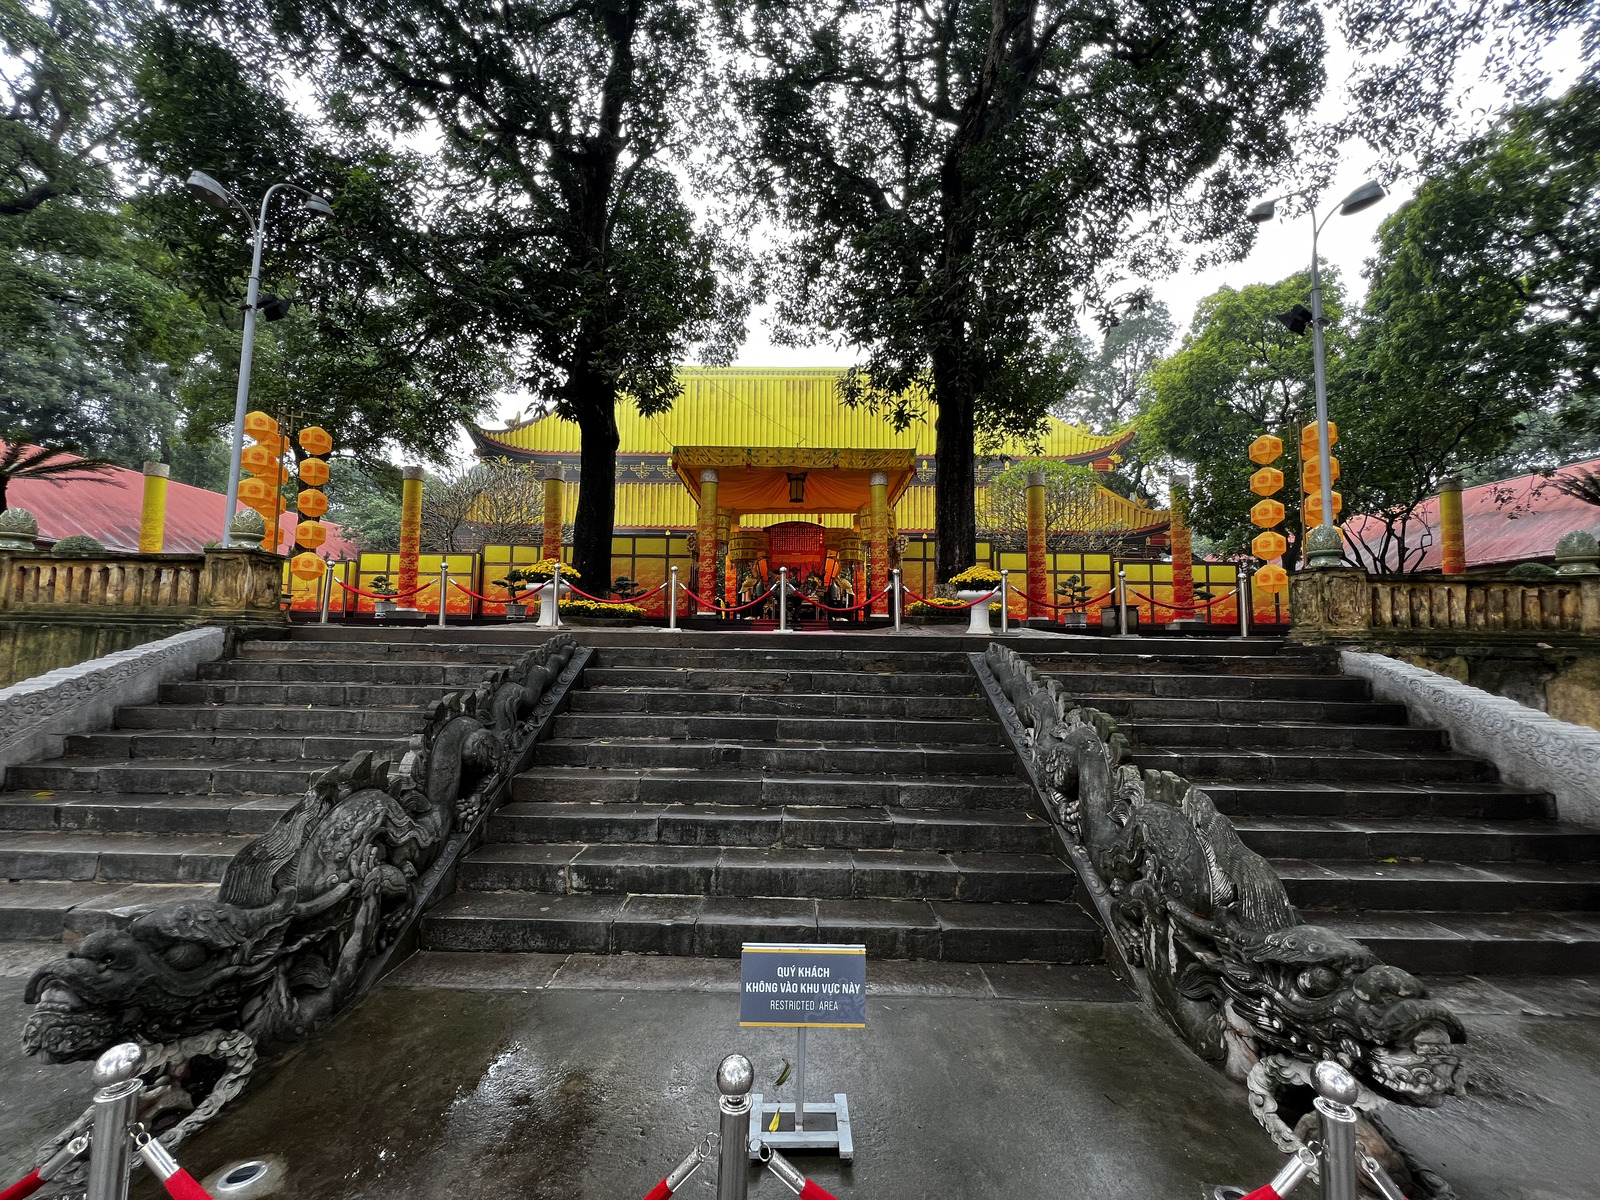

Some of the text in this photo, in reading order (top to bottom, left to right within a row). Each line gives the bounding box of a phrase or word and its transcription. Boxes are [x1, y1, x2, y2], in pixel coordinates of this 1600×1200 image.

[777, 965, 830, 978] QUÝ KHÁCH
[745, 981, 861, 996] KHÔNG VÀO KHU VỰC NÀY
[770, 1000, 839, 1011] RESTRICTED AREA
